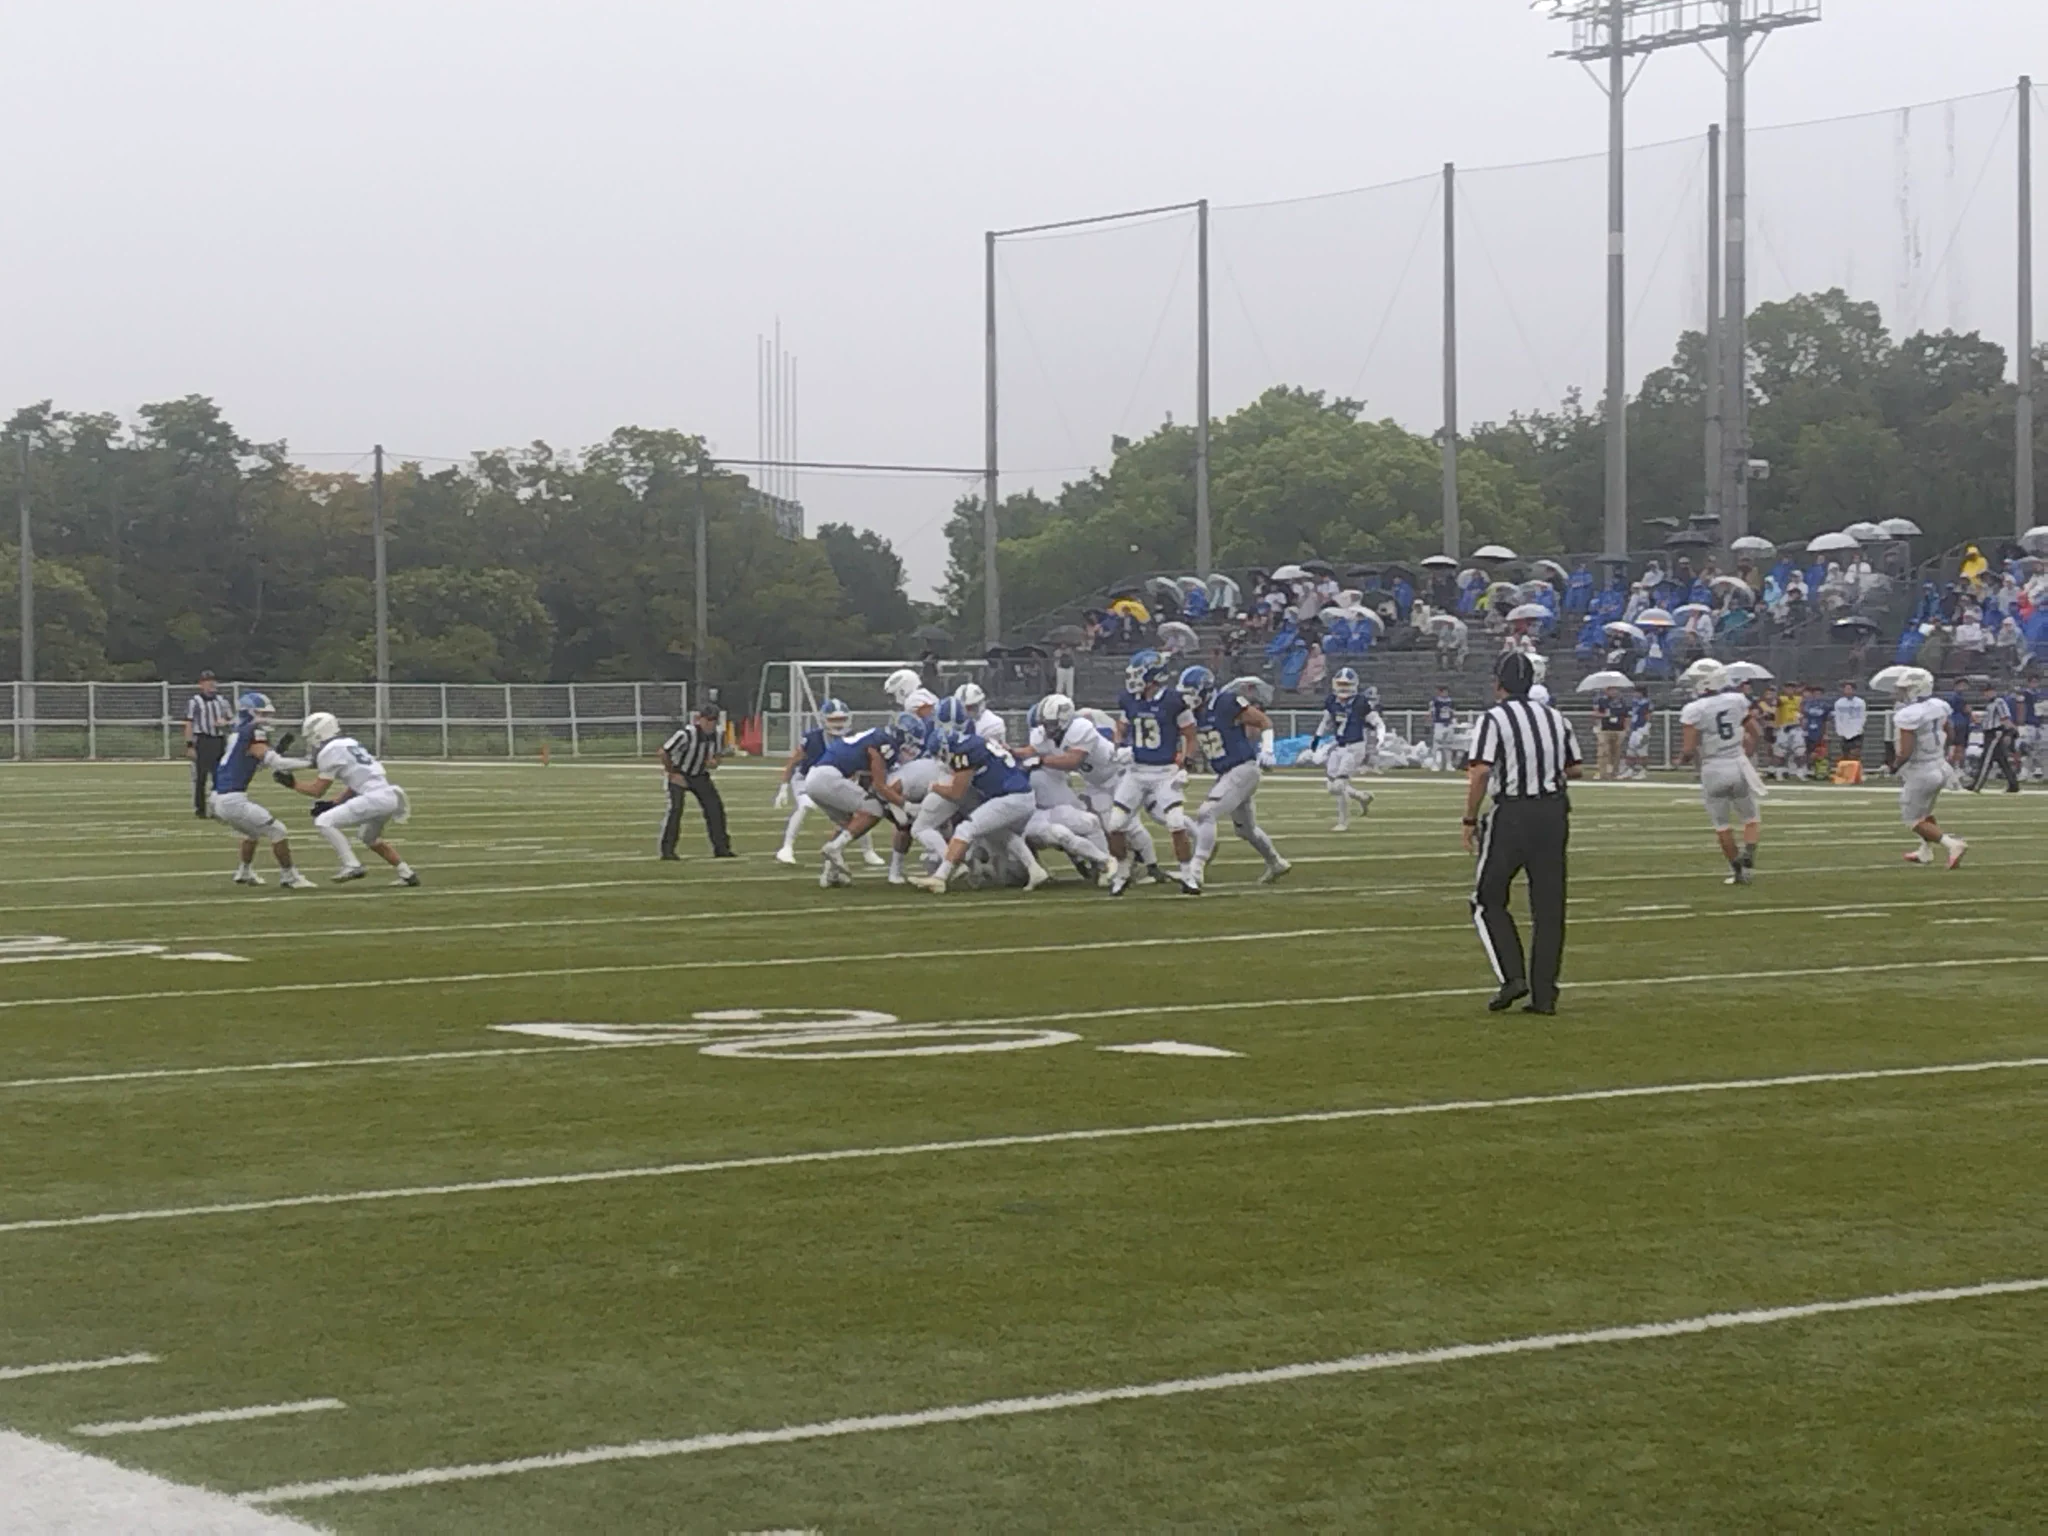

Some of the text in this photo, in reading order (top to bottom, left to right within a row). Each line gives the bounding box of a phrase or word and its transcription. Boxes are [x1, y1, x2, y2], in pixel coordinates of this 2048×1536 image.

[1132, 717, 1162, 750] 13
[1715, 709, 1735, 740] 6
[486, 1008, 1082, 1060] 20
